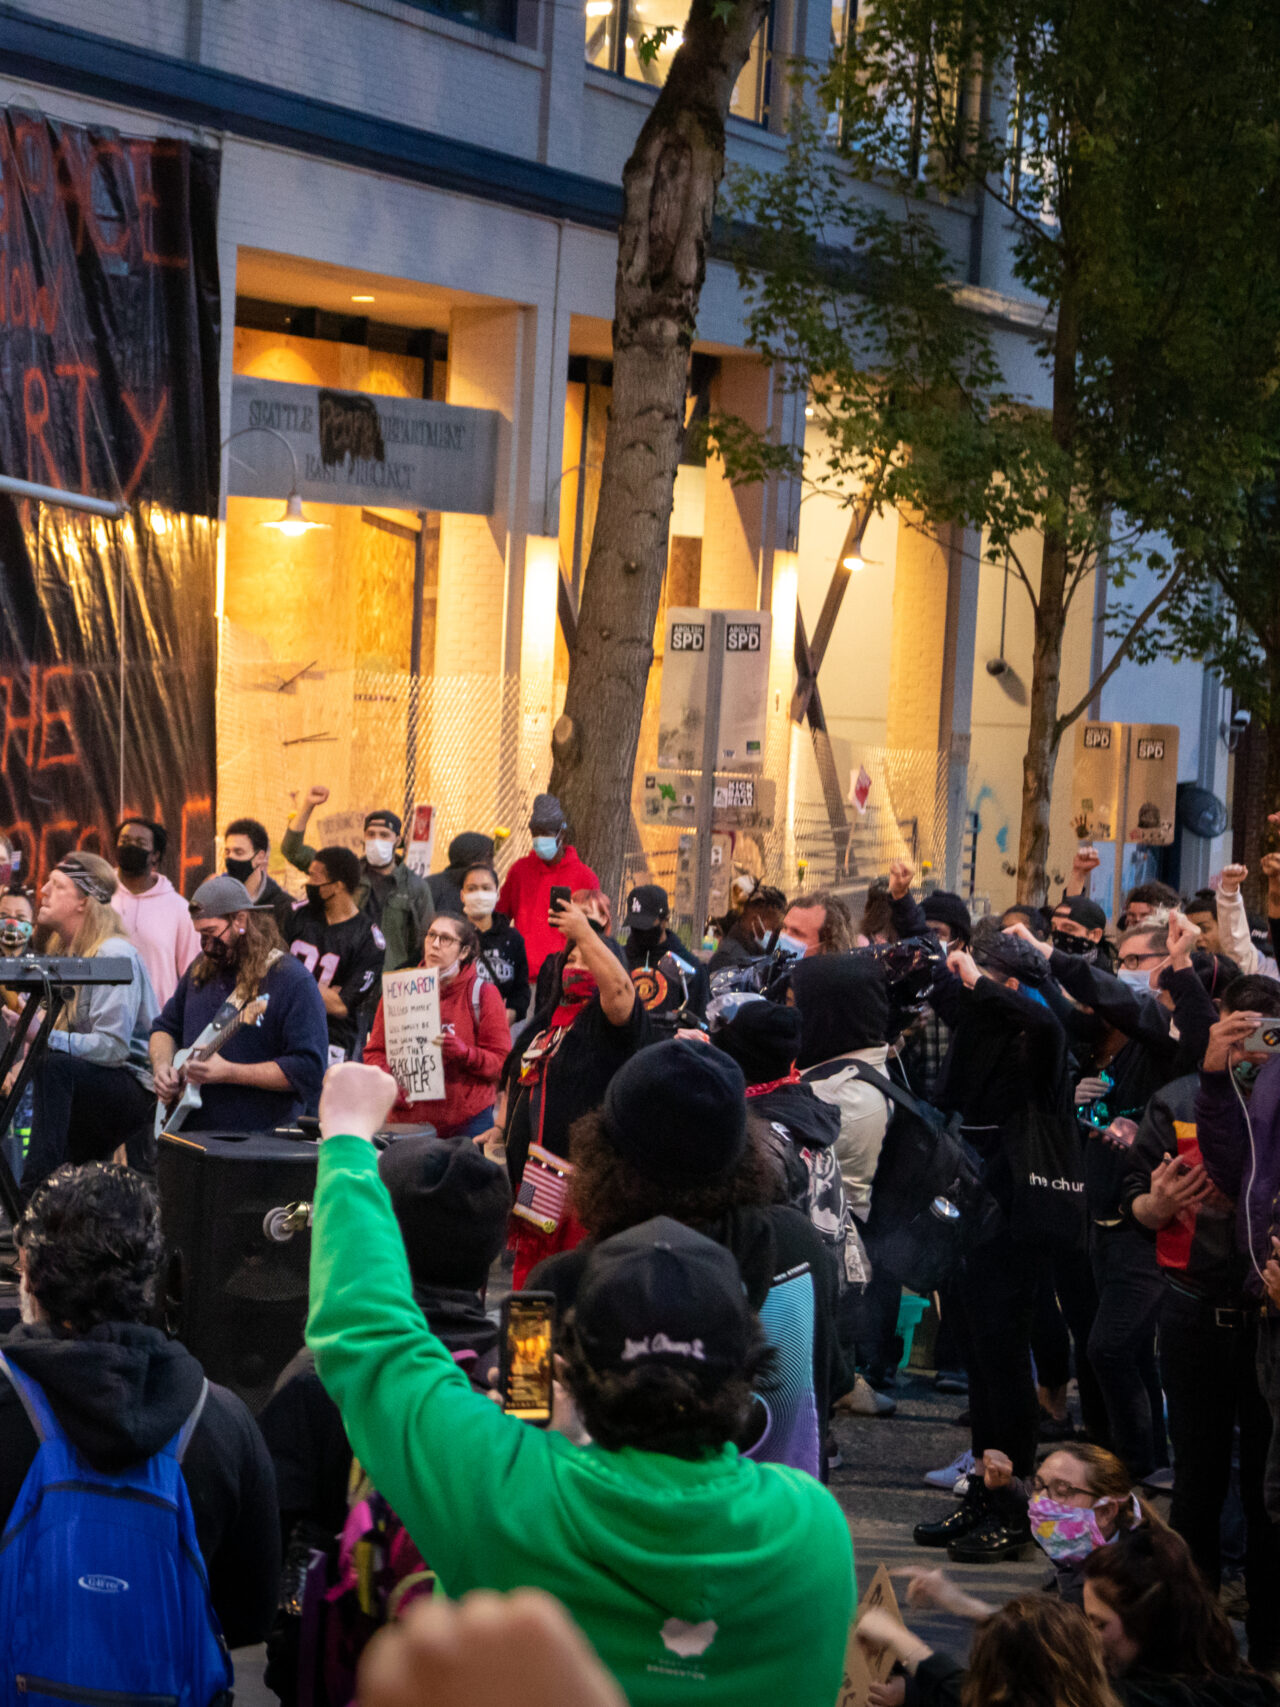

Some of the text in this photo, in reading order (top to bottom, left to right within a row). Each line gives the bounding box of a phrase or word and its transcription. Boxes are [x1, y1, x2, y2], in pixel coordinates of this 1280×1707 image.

[249, 400, 314, 434] SEATTLE
[348, 459, 417, 490] PRECINCT
[672, 633, 704, 650] SPD
[727, 633, 760, 649] SPD
[1085, 733, 1110, 747] SPD
[1139, 745, 1164, 759] SPD
[728, 782, 754, 790] KICK
[728, 790, 754, 798] BACK
[727, 799, 754, 807] RELAX
[387, 976, 435, 999] HEY KAREN
[411, 1055, 436, 1075] LIVES
